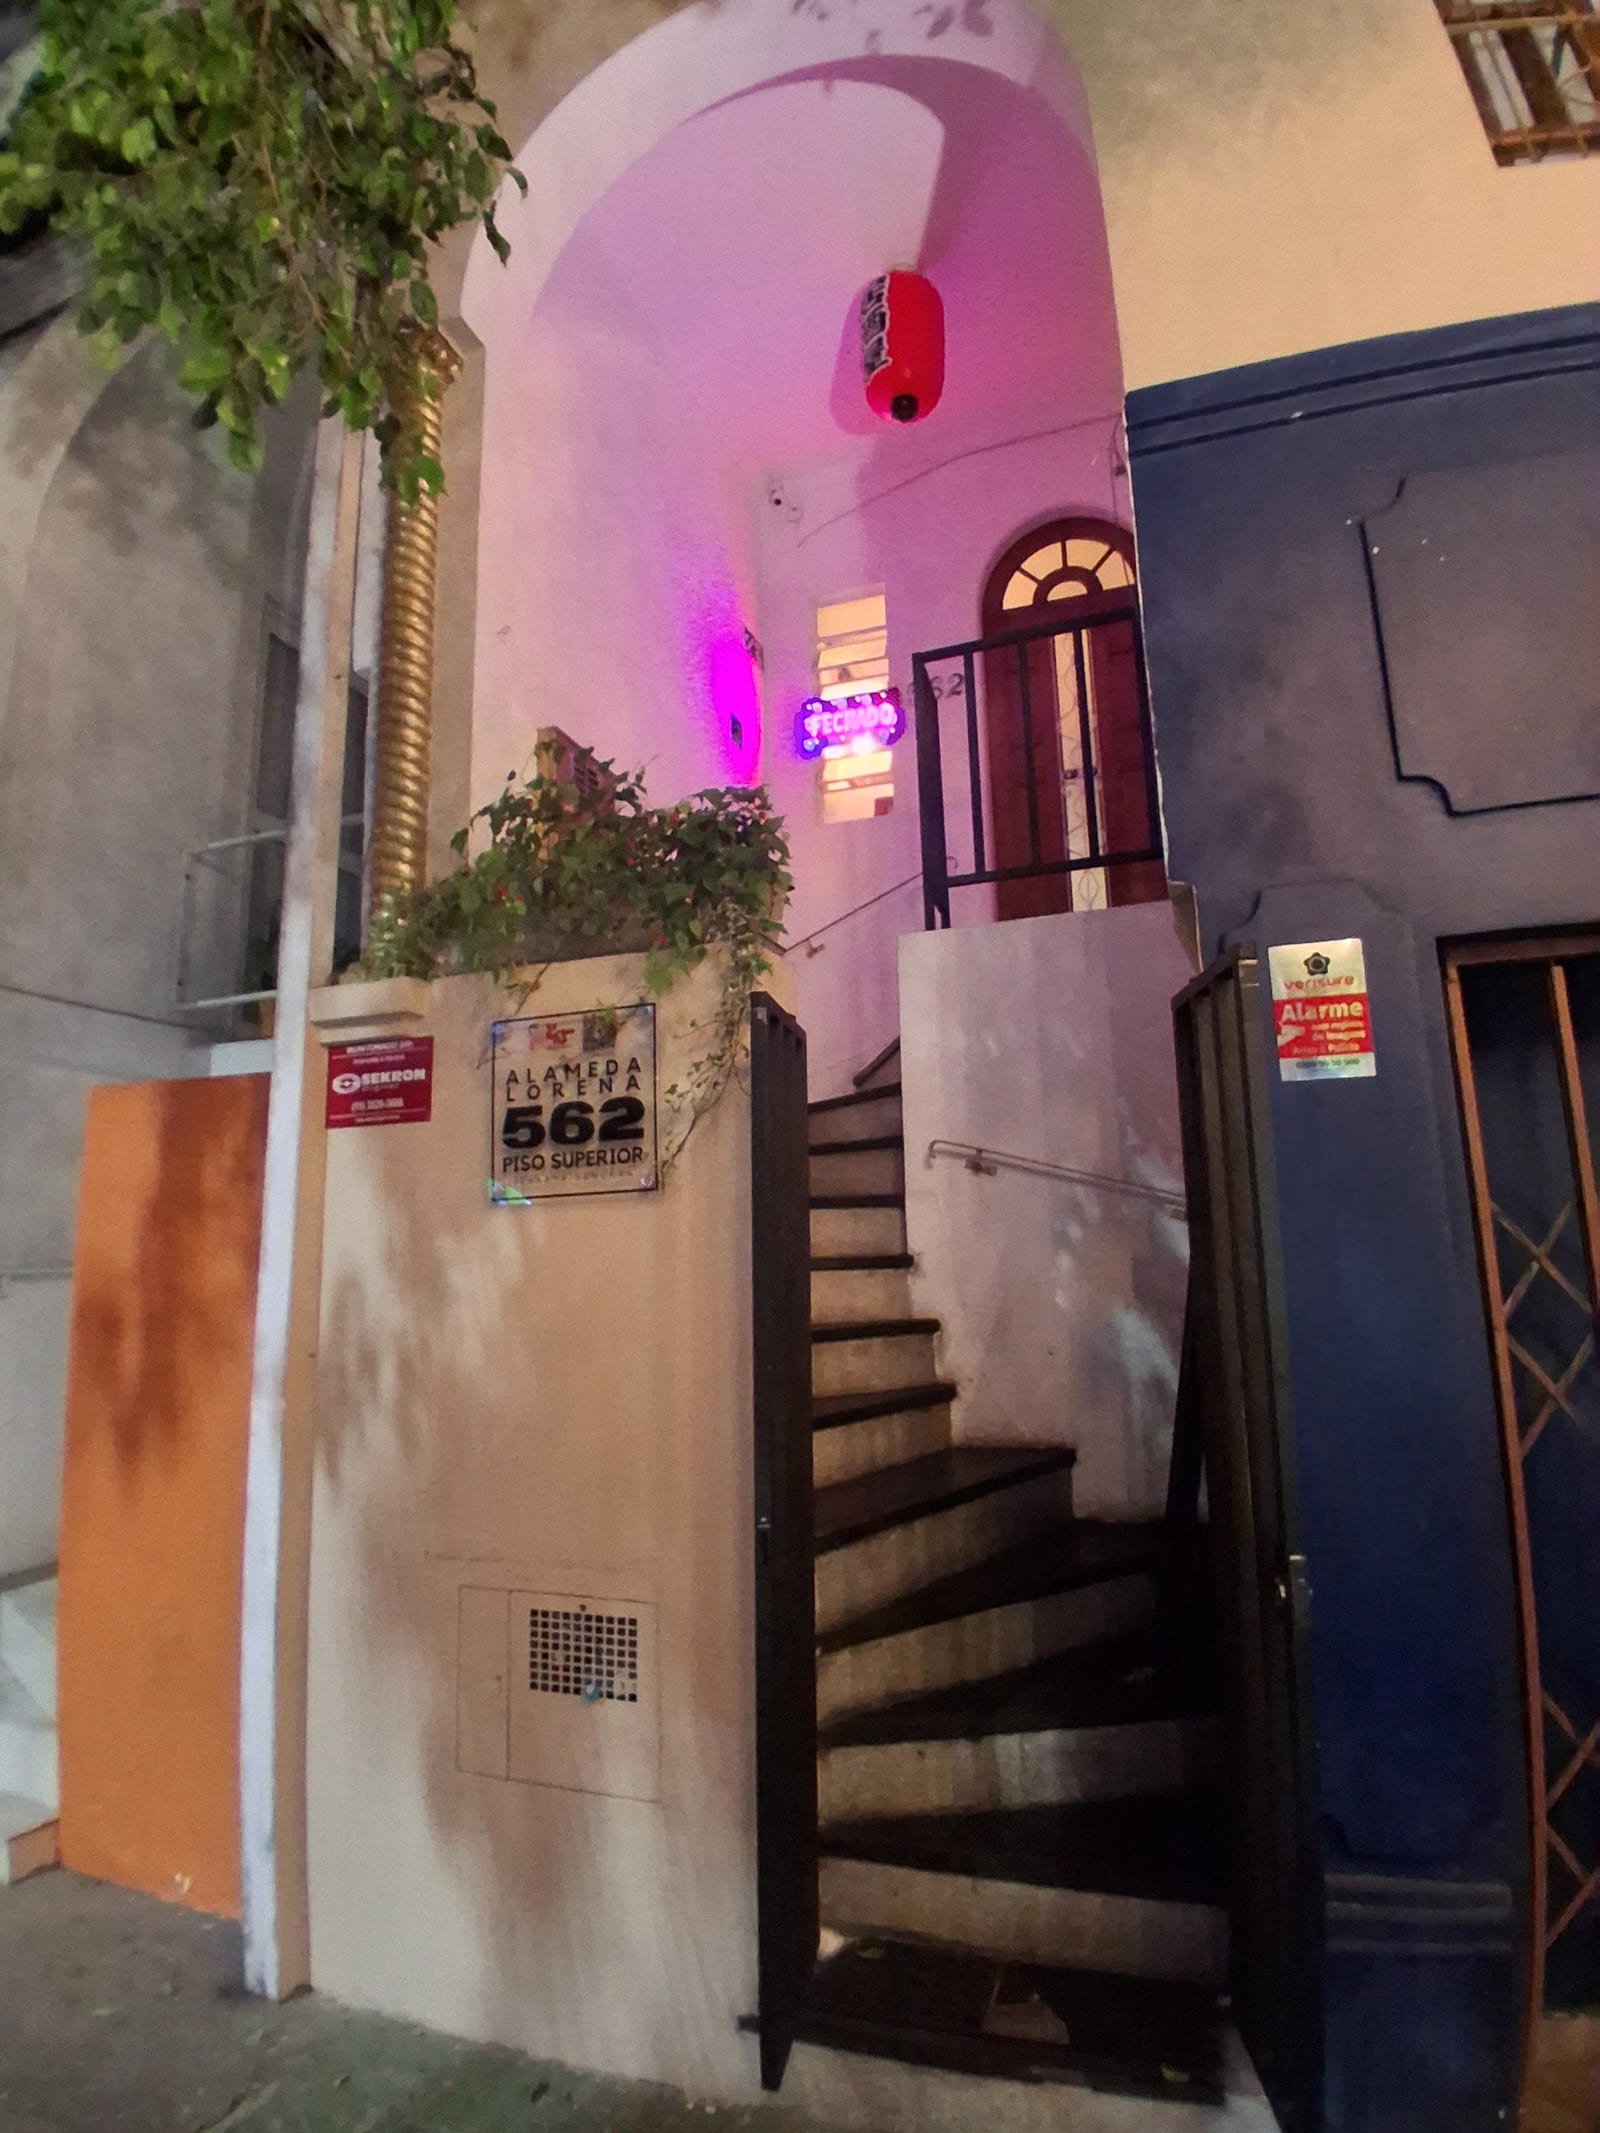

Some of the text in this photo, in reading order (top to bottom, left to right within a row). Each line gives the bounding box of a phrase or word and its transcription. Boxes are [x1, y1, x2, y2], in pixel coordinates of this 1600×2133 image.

[1284, 975, 1354, 990] verisure
[1281, 1001, 1364, 1021] Alarme
[361, 1068, 426, 1085] SEKRON
[506, 1057, 641, 1085] ALAMEDA
[507, 1075, 640, 1102] LORENA
[502, 1096, 645, 1149] 562
[502, 1146, 643, 1173] PISO SUPERIOR
